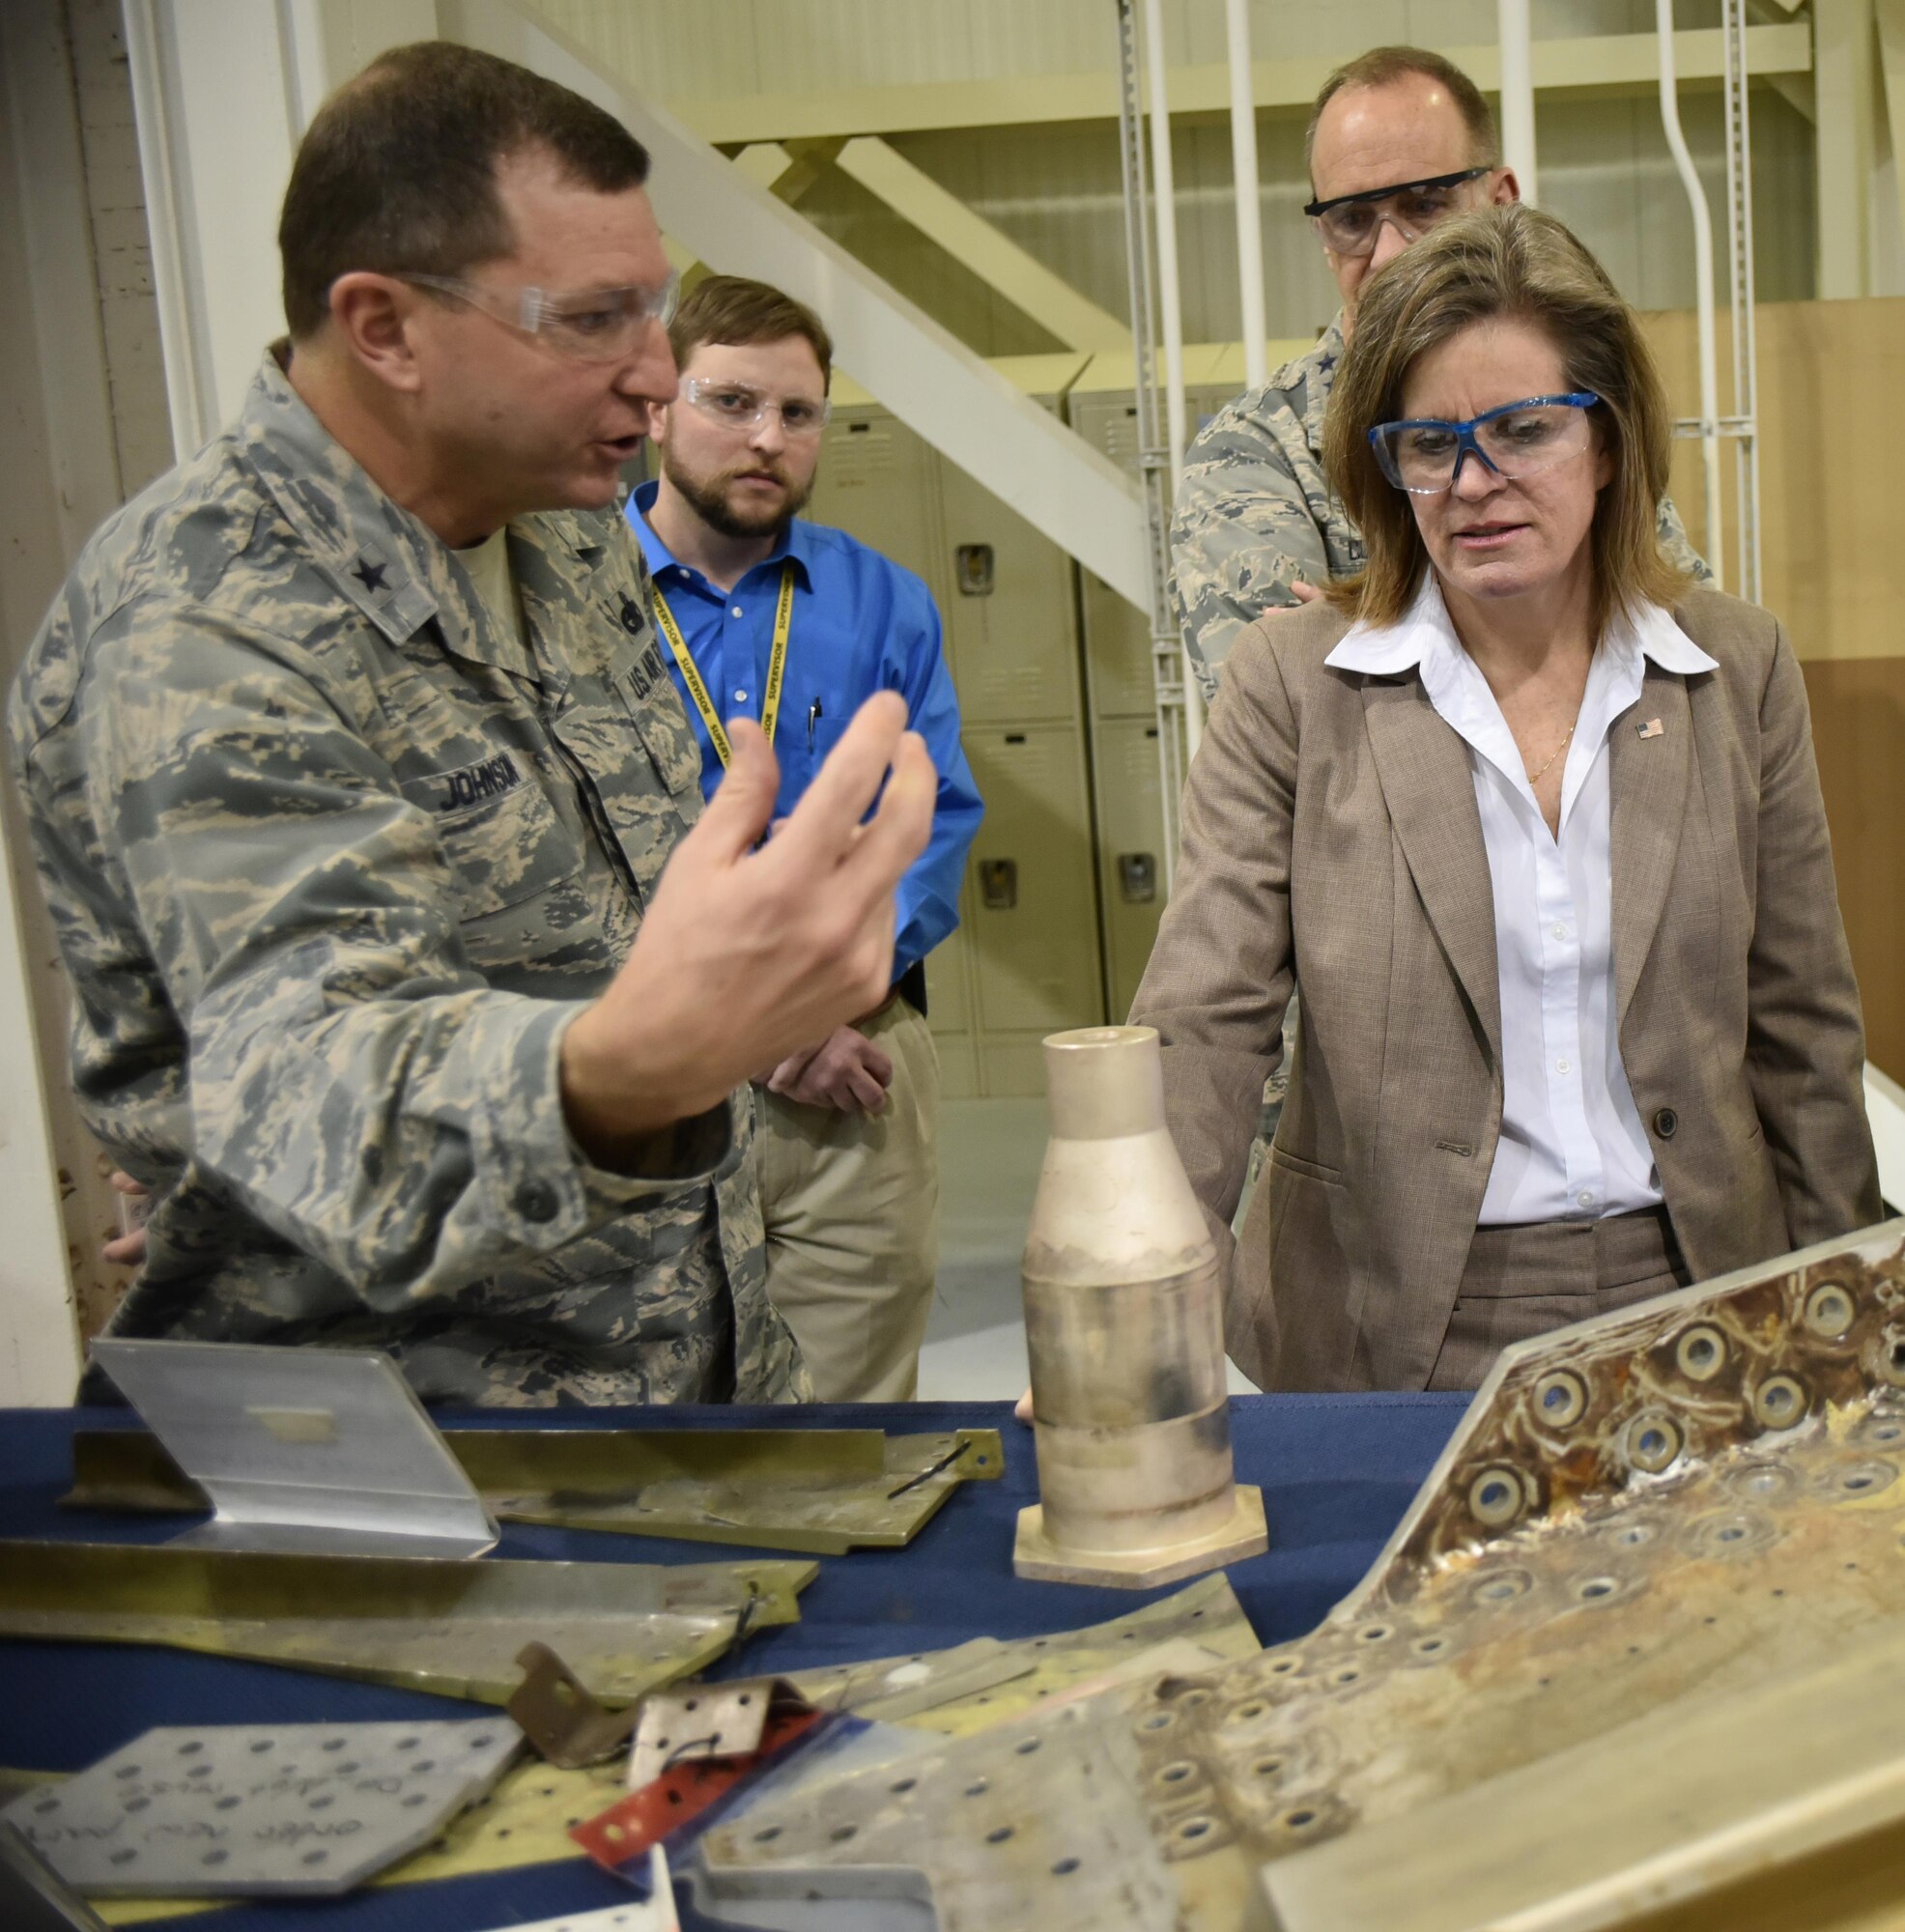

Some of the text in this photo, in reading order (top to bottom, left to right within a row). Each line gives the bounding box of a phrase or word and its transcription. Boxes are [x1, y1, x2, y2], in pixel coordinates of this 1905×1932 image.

[768, 642, 783, 699] SUPERVISOR
[680, 657, 710, 715] SUPERVISOR
[711, 724, 730, 759] SUPERV
[440, 752, 521, 810] JOHNSON
